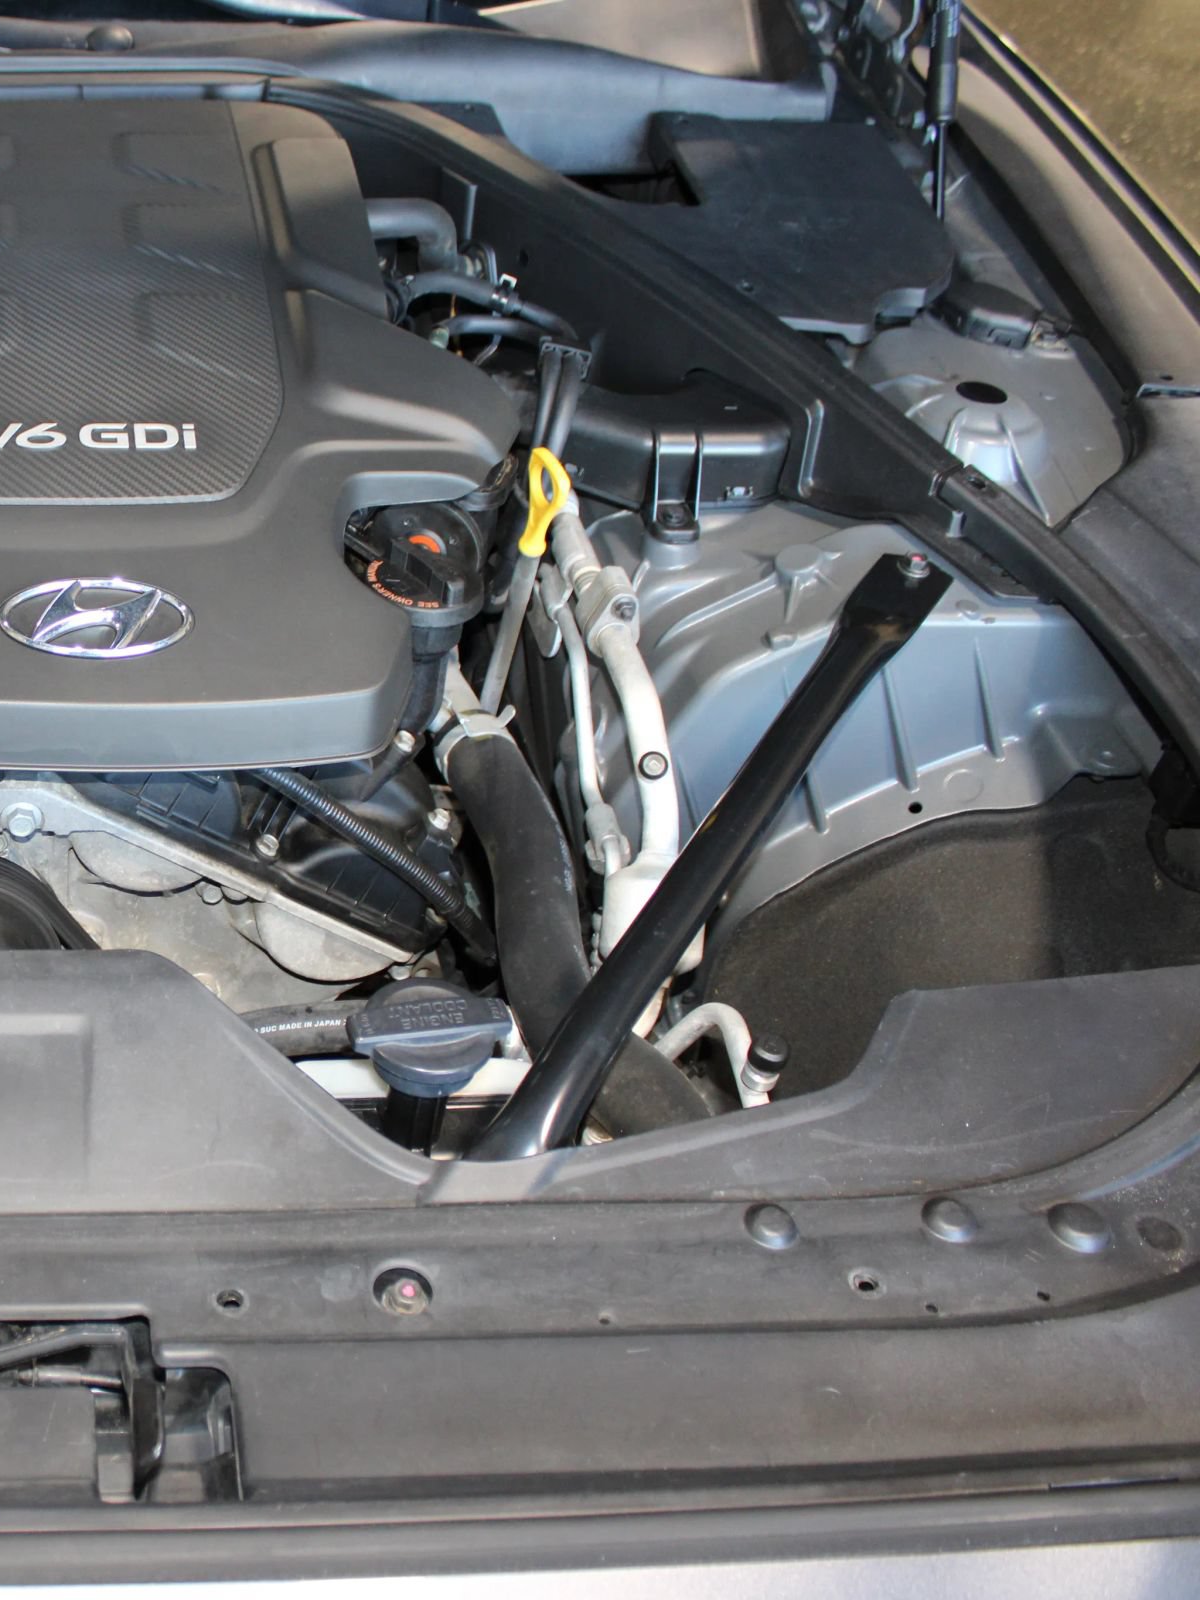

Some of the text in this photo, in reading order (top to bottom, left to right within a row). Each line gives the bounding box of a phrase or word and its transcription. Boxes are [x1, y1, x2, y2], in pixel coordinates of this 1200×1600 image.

[78, 422, 198, 449] GDi
[417, 600, 440, 608] SEE
[388, 999, 468, 1018] COOLANT
[278, 1021, 302, 1032] MADE
[303, 1020, 313, 1028] IN
[314, 1018, 342, 1027] JAPAN
[401, 1012, 465, 1030] ENGINE
